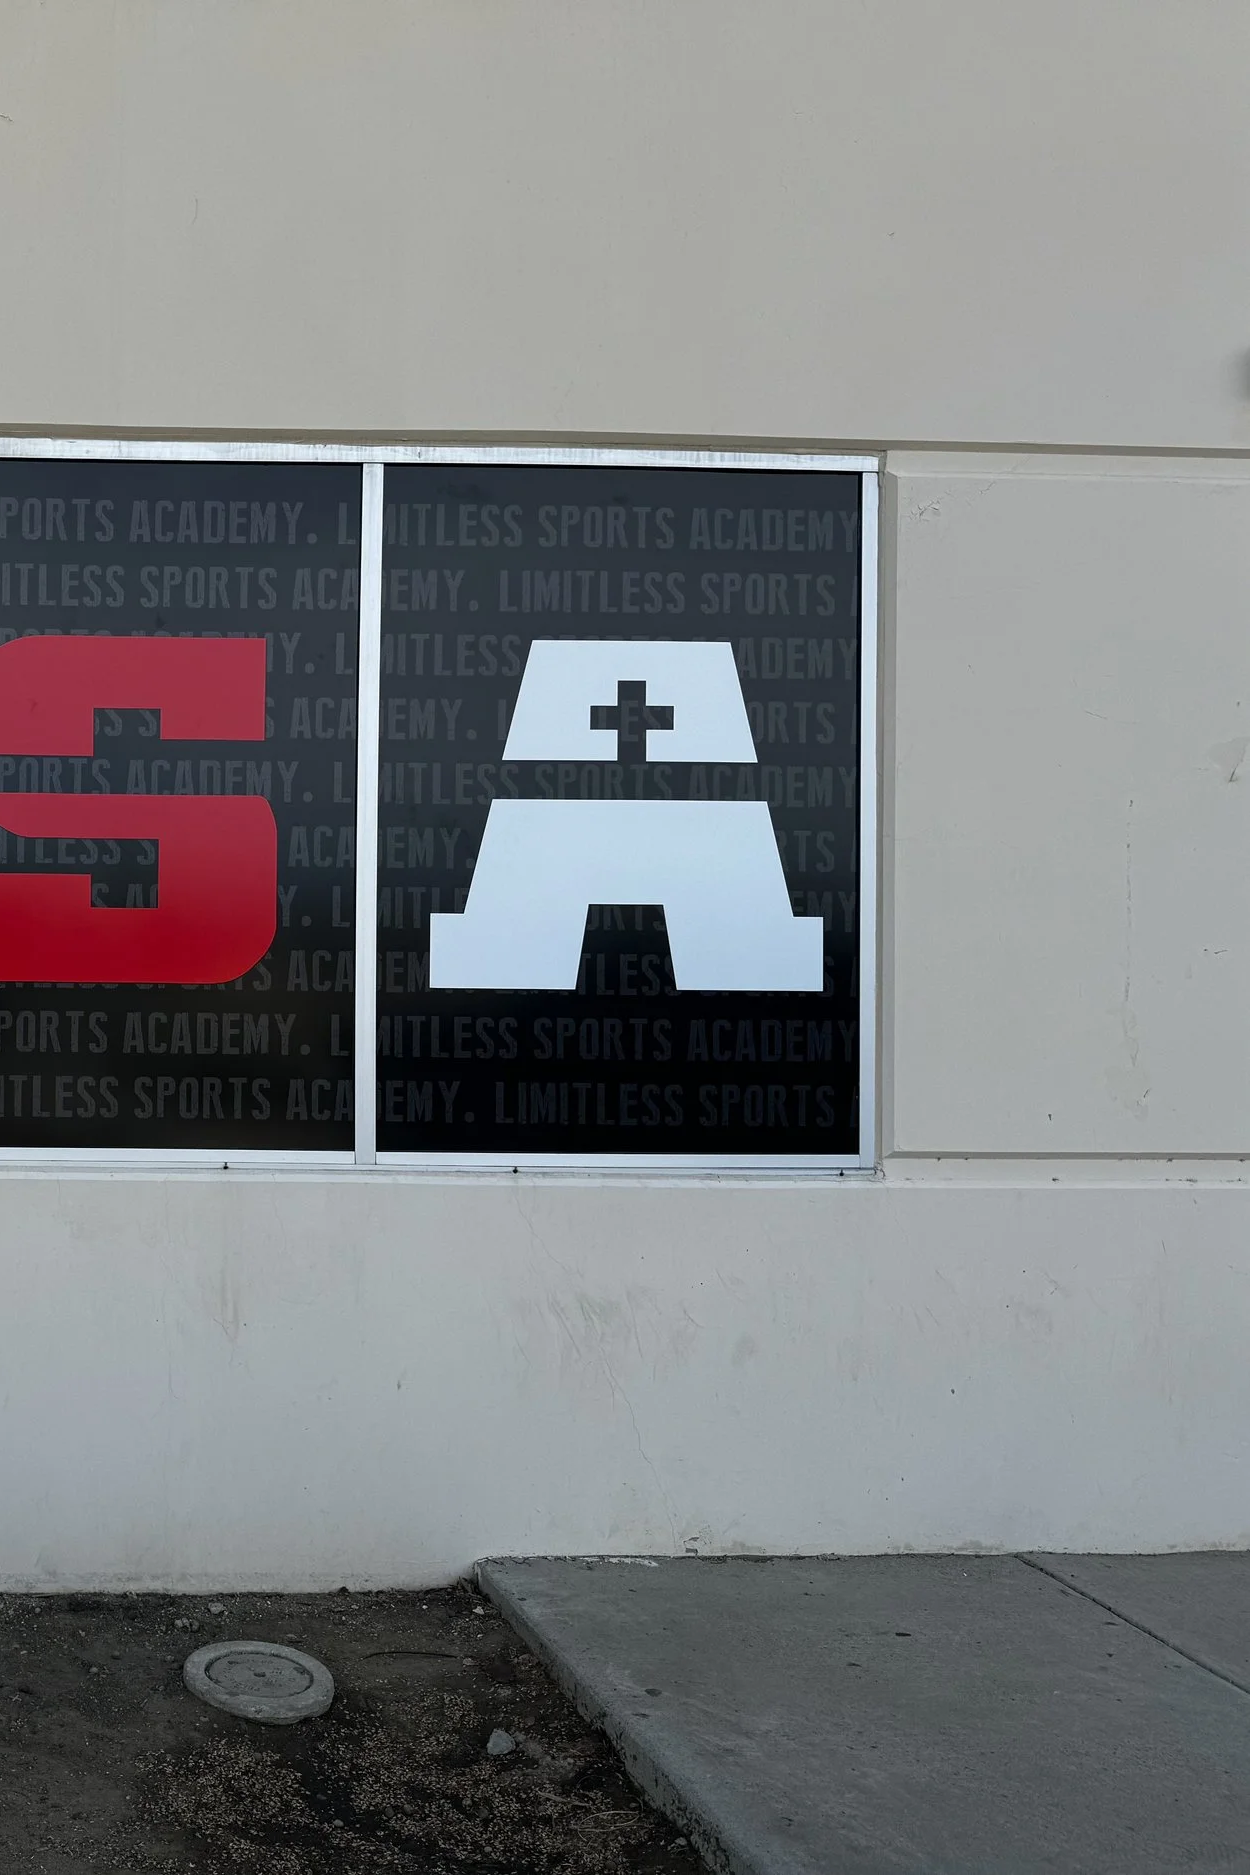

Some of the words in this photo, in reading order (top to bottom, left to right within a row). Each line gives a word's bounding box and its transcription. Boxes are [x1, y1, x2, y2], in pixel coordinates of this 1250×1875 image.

[129, 500, 318, 544] ACADEMY.
[538, 504, 675, 549] SPORTS
[140, 566, 278, 610] SPORTS
[499, 570, 686, 614] LIMITLESS
[700, 572, 836, 617] SPORTS
[536, 763, 674, 799] SPORTS
[122, 1012, 311, 1056] ACADEMY.
[533, 1016, 672, 1061] SPORTS
[133, 1076, 271, 1120] SPORTS
[495, 1080, 684, 1126] LIMITLESS
[699, 1084, 835, 1128] SPORTS
